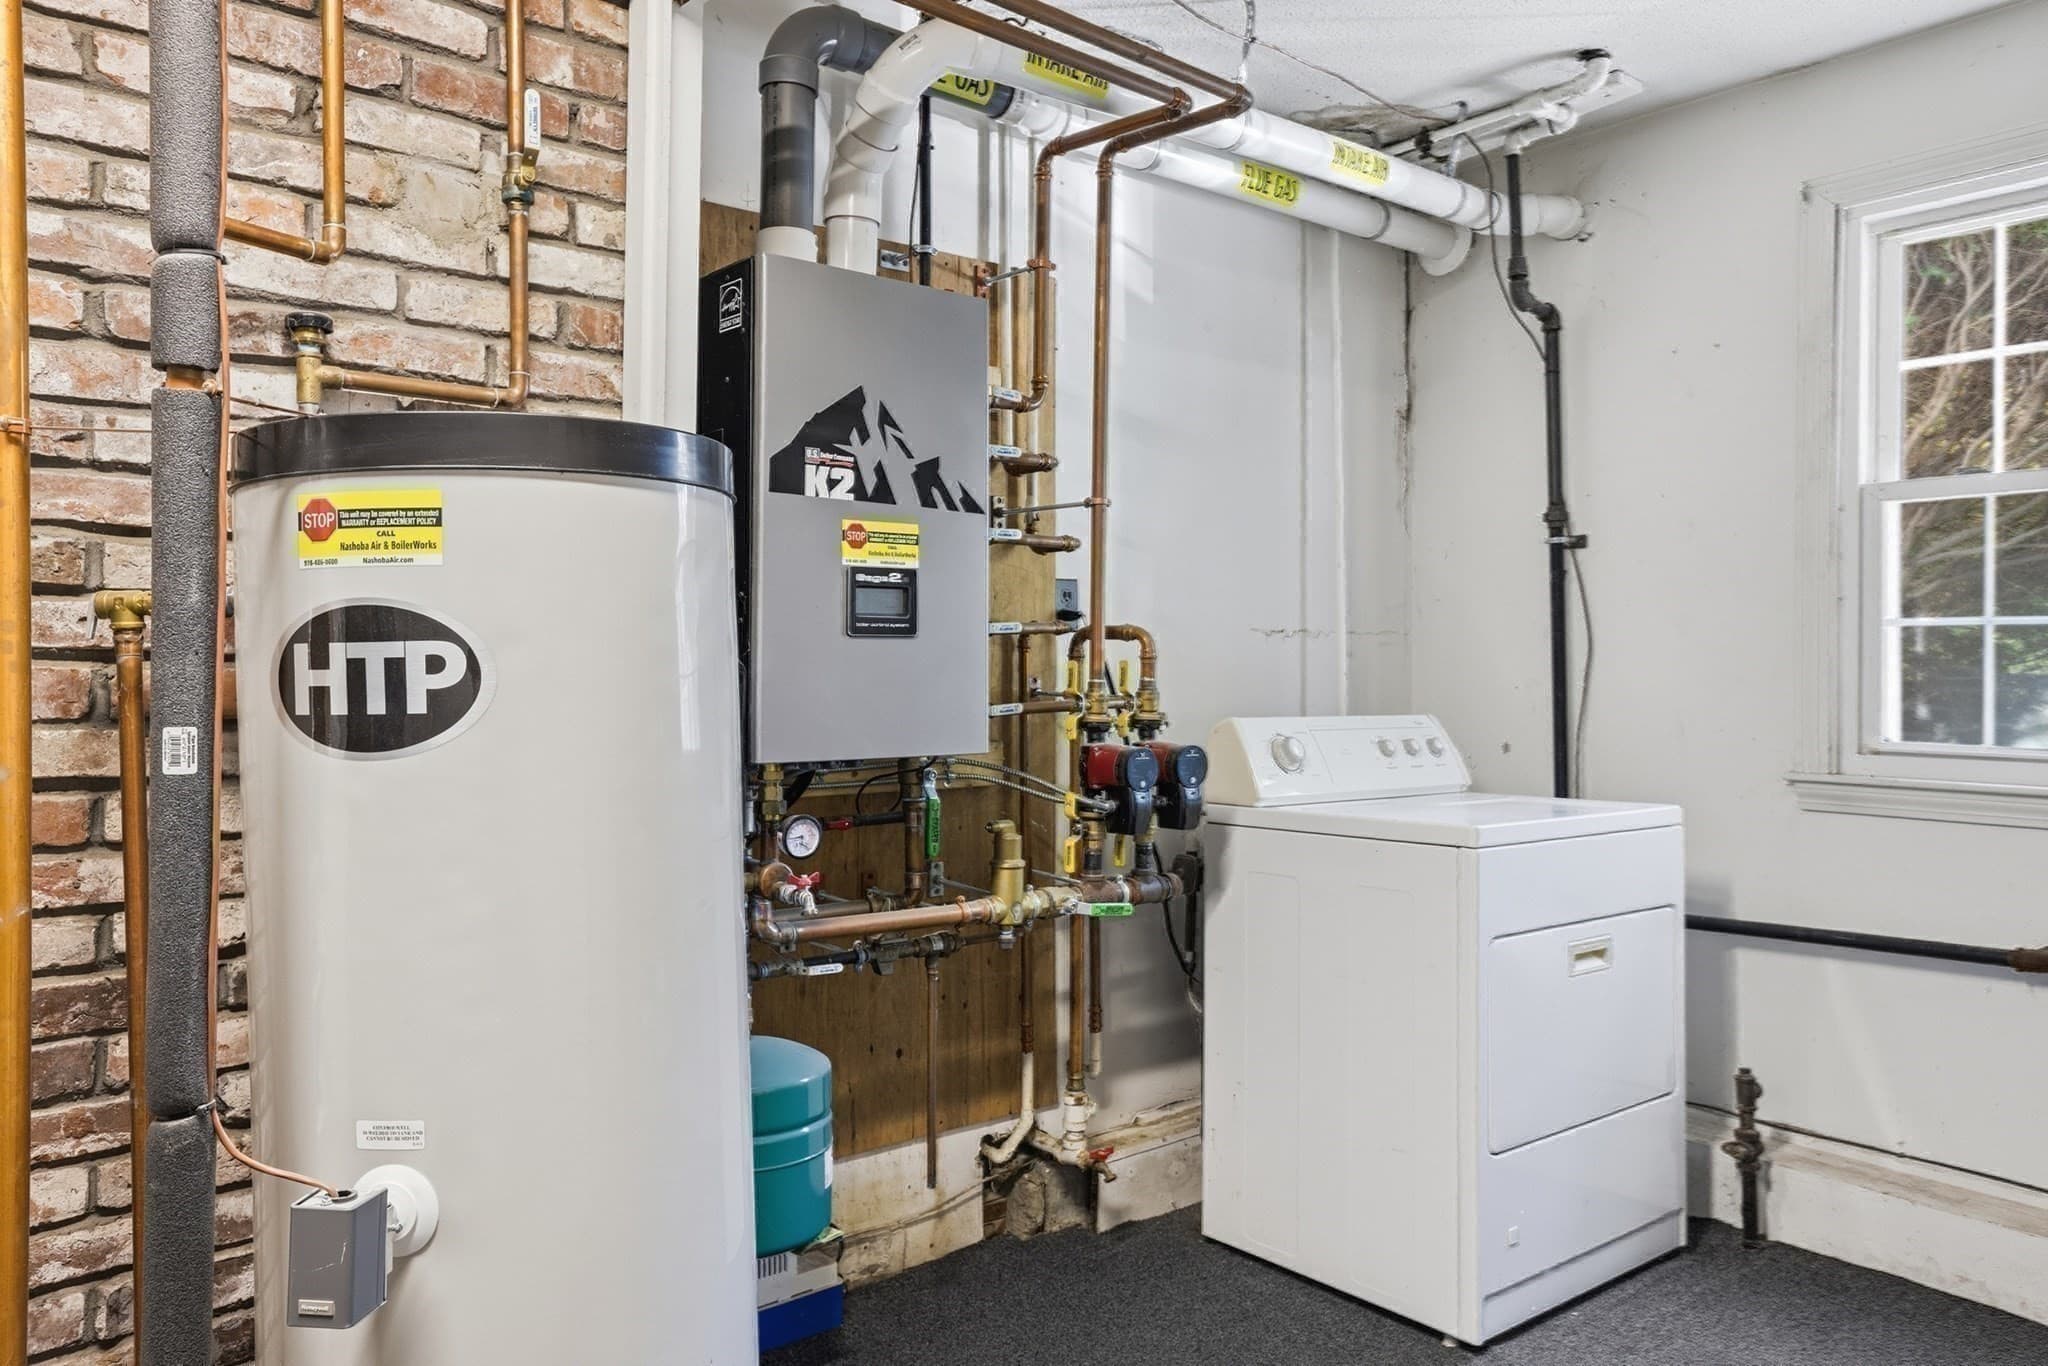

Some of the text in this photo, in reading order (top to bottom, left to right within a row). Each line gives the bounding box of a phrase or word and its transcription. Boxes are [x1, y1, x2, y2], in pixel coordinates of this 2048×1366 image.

[1240, 164, 1297, 202] FLUE GAS
[804, 463, 855, 501] K2
[304, 512, 335, 529] STOP
[846, 531, 866, 542] STOP
[340, 540, 437, 551] Nashoba Air & BoilerWorks
[362, 556, 414, 564] NashobaAir.com
[293, 640, 467, 716] HTP
